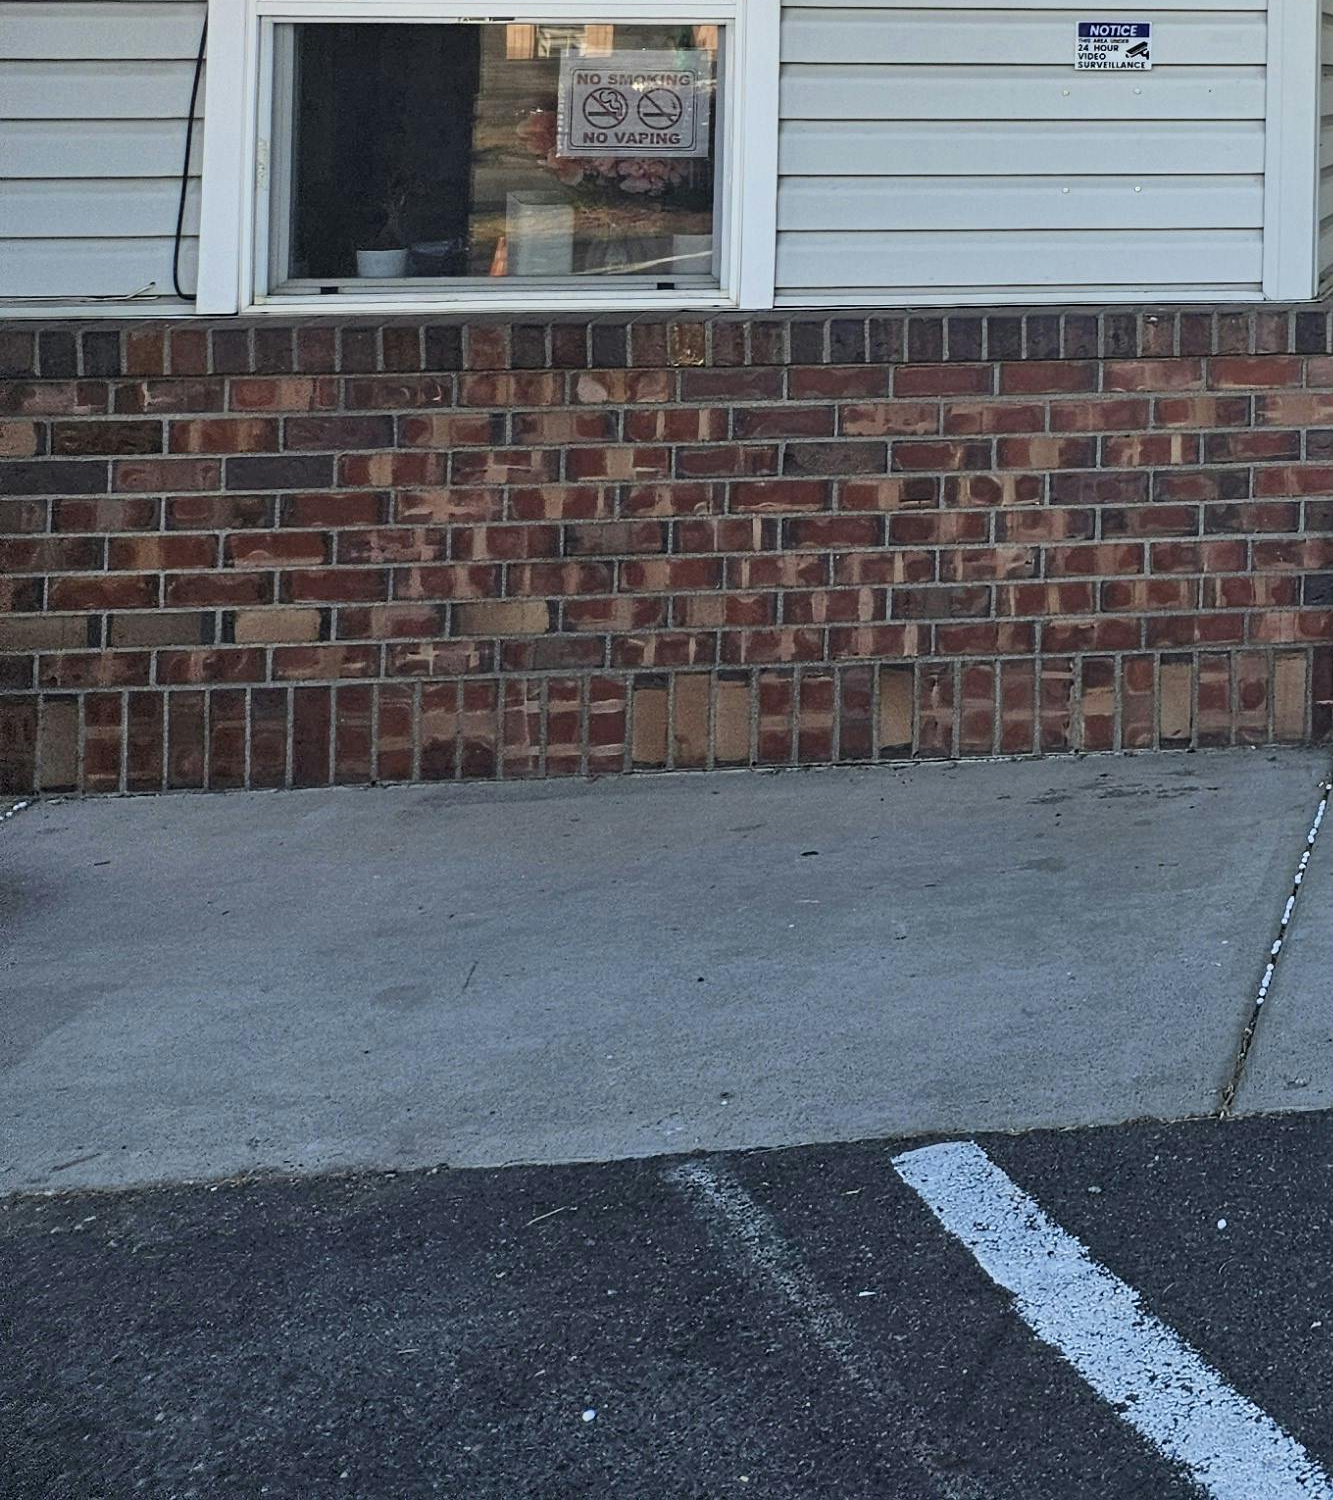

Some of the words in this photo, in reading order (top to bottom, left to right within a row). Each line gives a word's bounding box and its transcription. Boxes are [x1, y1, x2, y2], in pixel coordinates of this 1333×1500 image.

[1089, 25, 1138, 37] NOTICE
[1078, 44, 1089, 52] 24
[1093, 44, 1119, 52] HOUR
[1078, 52, 1107, 60] VIDEO
[1077, 61, 1146, 69] SURVEILLANCE
[576, 73, 602, 85] NO
[607, 73, 691, 86] SMOKING
[583, 132, 608, 144] NO
[614, 132, 682, 145] VAPING
